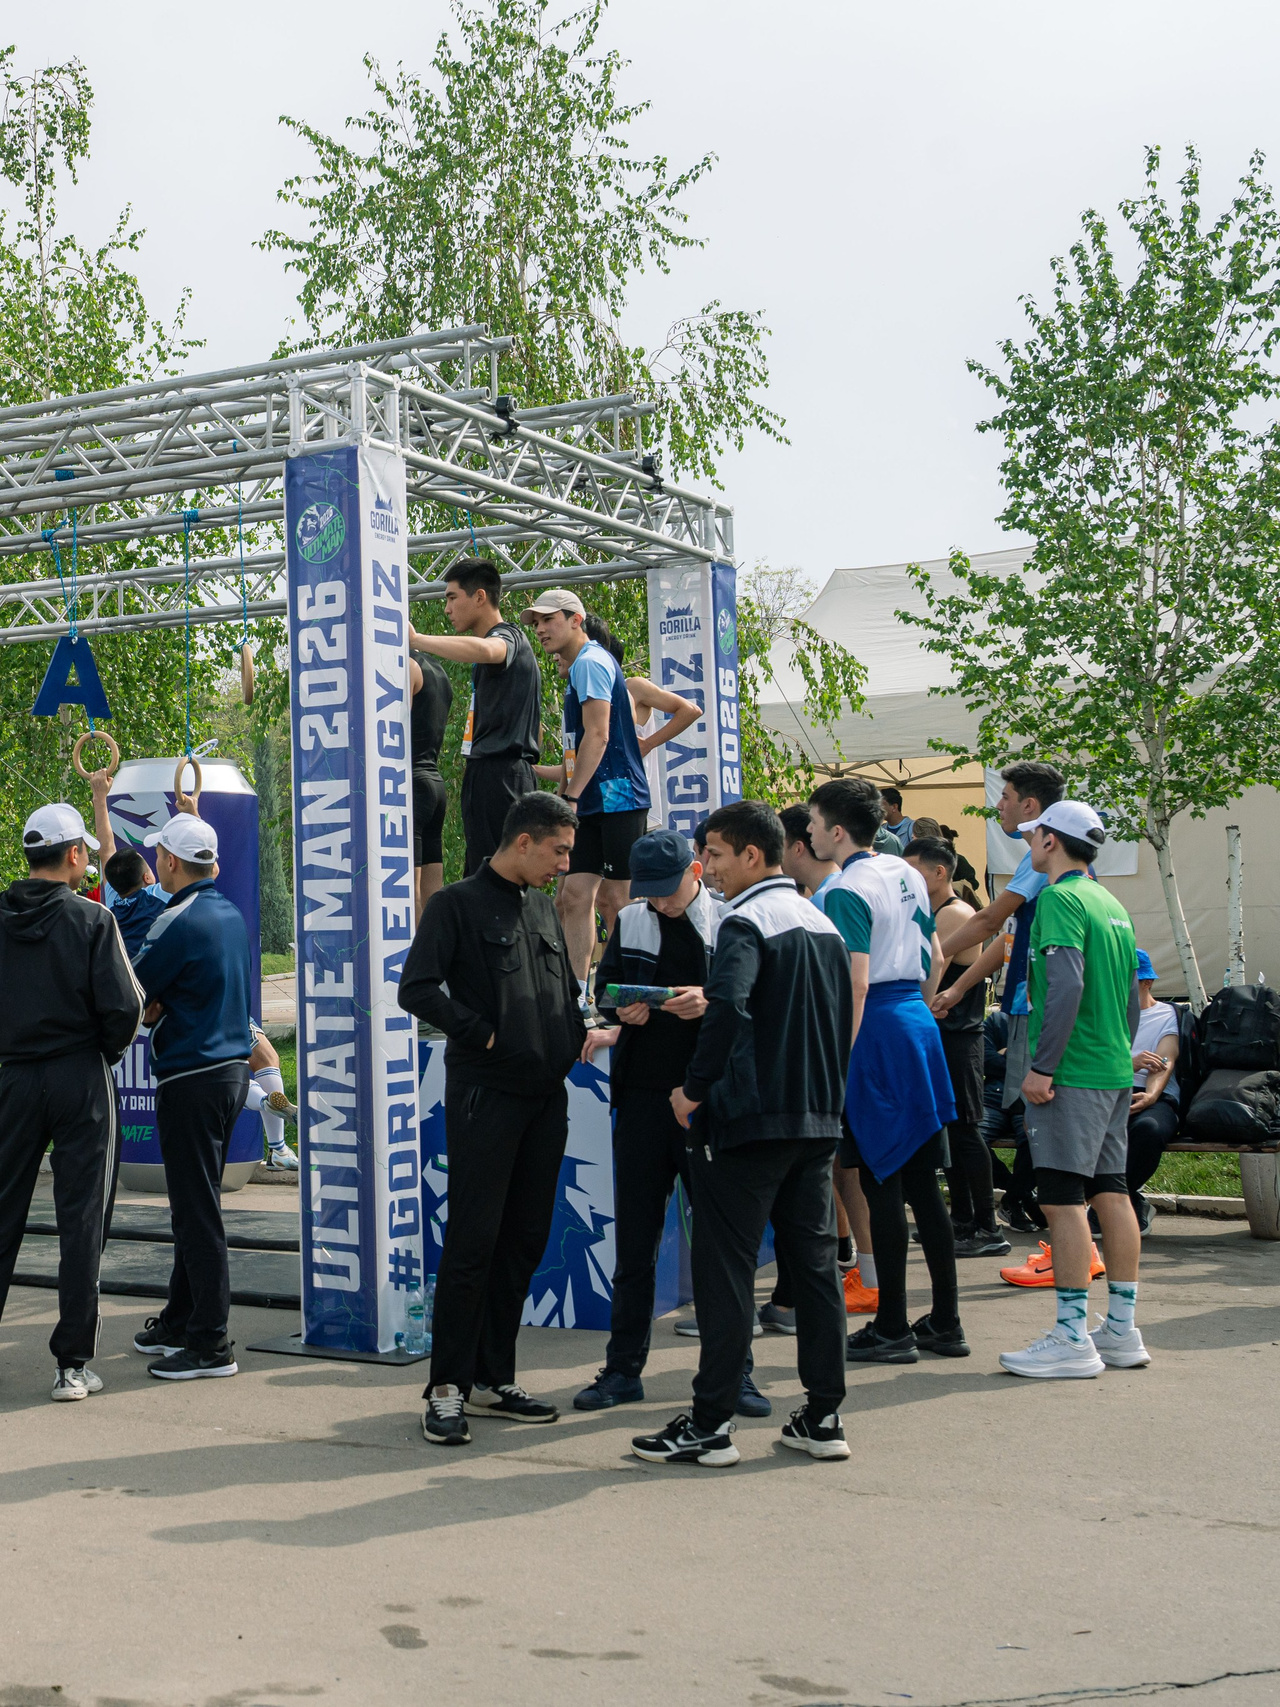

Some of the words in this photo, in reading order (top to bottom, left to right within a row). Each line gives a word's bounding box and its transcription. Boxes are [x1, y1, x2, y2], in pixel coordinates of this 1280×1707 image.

[370, 510, 400, 536] GORILLA
[297, 580, 349, 751] 2026
[660, 617, 701, 635] GORILLA
[719, 666, 740, 795] 2026
[301, 779, 353, 931] MAN
[121, 1125, 154, 1143] MATE
[305, 962, 361, 1292] ULTIMATE
